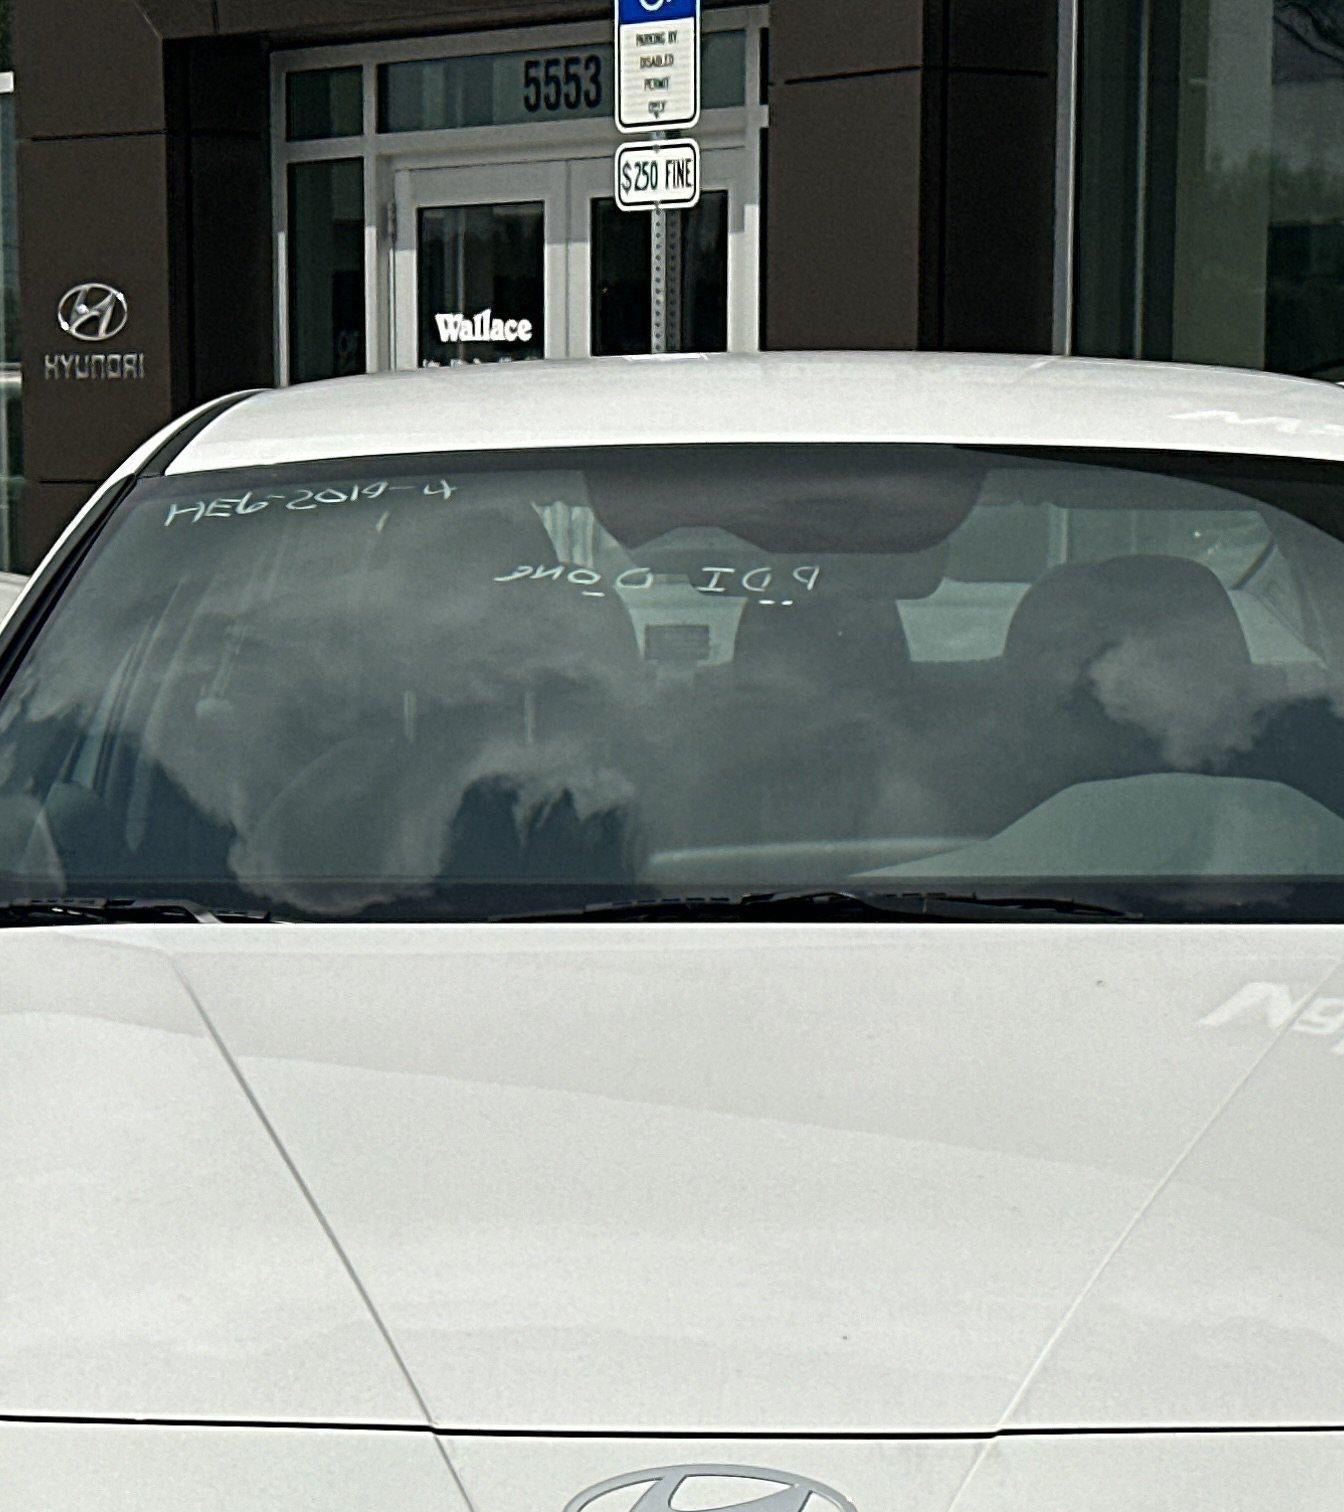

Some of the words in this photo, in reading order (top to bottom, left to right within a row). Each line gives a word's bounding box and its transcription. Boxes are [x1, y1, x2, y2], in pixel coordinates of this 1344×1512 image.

[636, 32, 665, 46] PARKING
[640, 53, 674, 69] DISABLED
[524, 54, 602, 112] 5553
[644, 75, 670, 91] PERMIT
[621, 160, 658, 195] $250
[665, 158, 692, 190] FINE
[434, 308, 533, 343] Wallace
[44, 352, 145, 380] HYUNDAI
